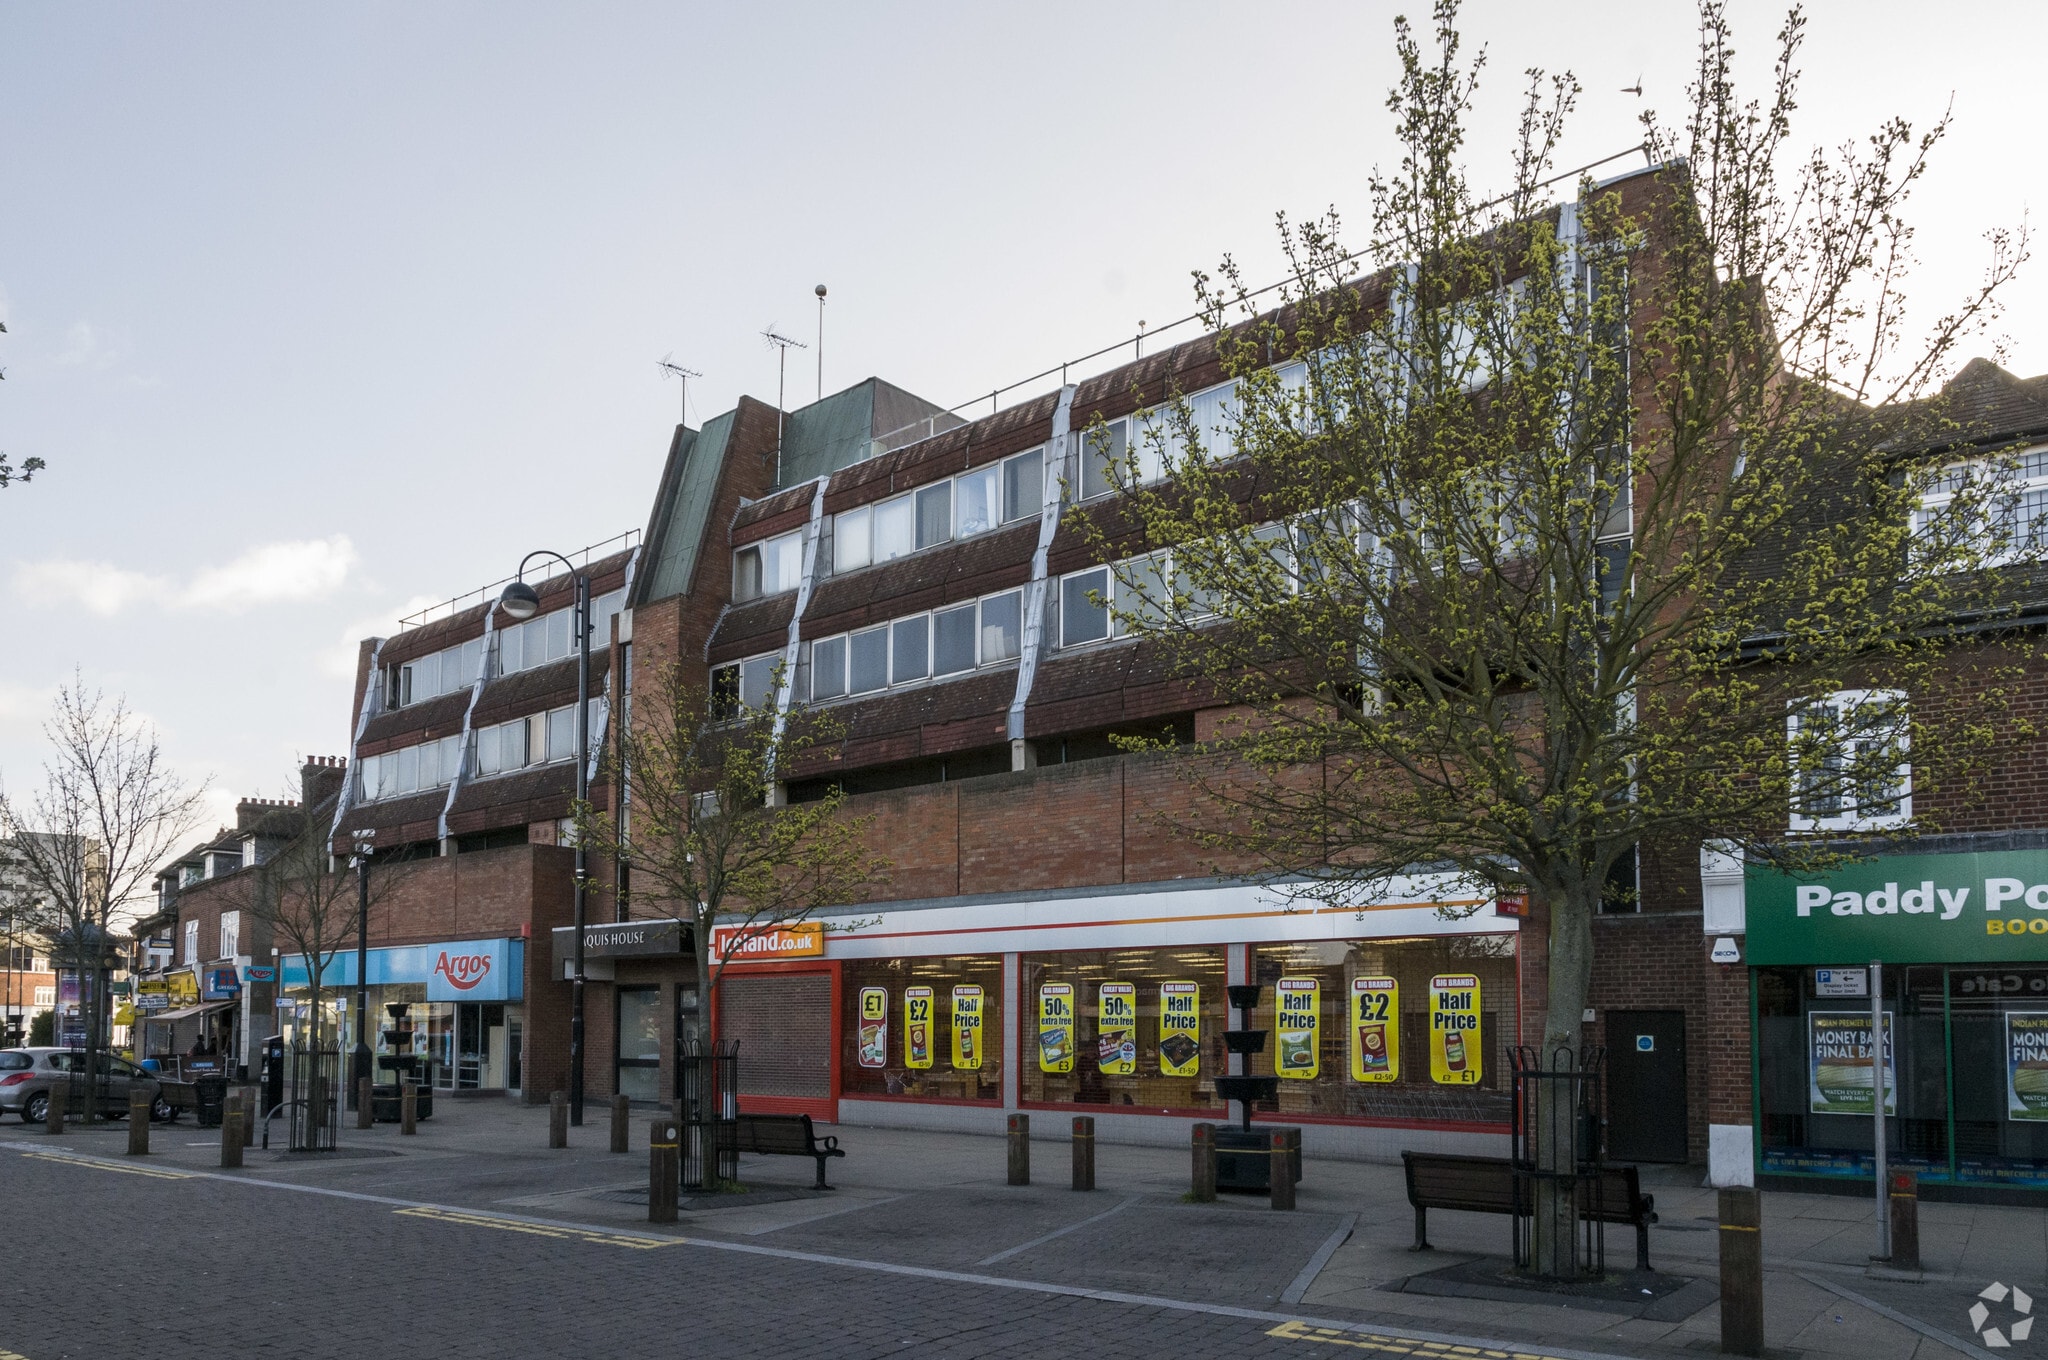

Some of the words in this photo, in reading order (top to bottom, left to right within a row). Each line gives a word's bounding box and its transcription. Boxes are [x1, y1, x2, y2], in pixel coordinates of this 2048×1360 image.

[1796, 881, 1970, 920] Paddy
[1986, 877, 2048, 912] Po
[1987, 919, 2048, 936] BOO
[611, 931, 645, 946] HOUSE
[248, 969, 273, 979] Argos
[434, 951, 492, 989] Argos
[1820, 971, 1829, 982] P
[1165, 984, 1174, 992] BIG
[1174, 984, 1196, 992] BRANDS
[1281, 981, 1292, 989] BIG
[1292, 981, 1315, 989] BRANDS
[1357, 981, 1368, 989] BIG
[1368, 981, 1393, 989] BRANDS
[1435, 979, 1448, 987] BIG
[1448, 978, 1474, 987] BRANDS
[865, 995, 882, 1011] £1
[958, 999, 978, 1012] Half
[1045, 998, 1070, 1016] 50%
[1105, 997, 1132, 1016] 50%
[1167, 996, 1193, 1011] Half
[1284, 994, 1312, 1010] Half
[1360, 993, 1389, 1021] £2
[1439, 992, 1472, 1010] Half
[910, 1000, 928, 1021] £2
[954, 1013, 980, 1027] Price
[1041, 1017, 1058, 1025] extra
[1058, 1017, 1072, 1025] free
[1101, 1017, 1119, 1025] extra
[1119, 1017, 1134, 1025] free
[1163, 1013, 1196, 1029] Price
[1279, 1012, 1316, 1029] Price
[1434, 1012, 1477, 1030] Price
[1815, 1019, 1837, 1027] INDIAN
[1838, 1019, 1865, 1027] PREMIER
[2012, 1019, 2038, 1028] INDIAN
[1816, 1031, 1857, 1044] MONEY
[1859, 1031, 1890, 1044] BAK
[1816, 1045, 1855, 1058] FINAL
[1858, 1046, 1890, 1059] BAL
[970, 1058, 979, 1067] £1
[1058, 1061, 1069, 1071] £3
[1119, 1062, 1131, 1073] £2
[1461, 1070, 1475, 1082] £1
